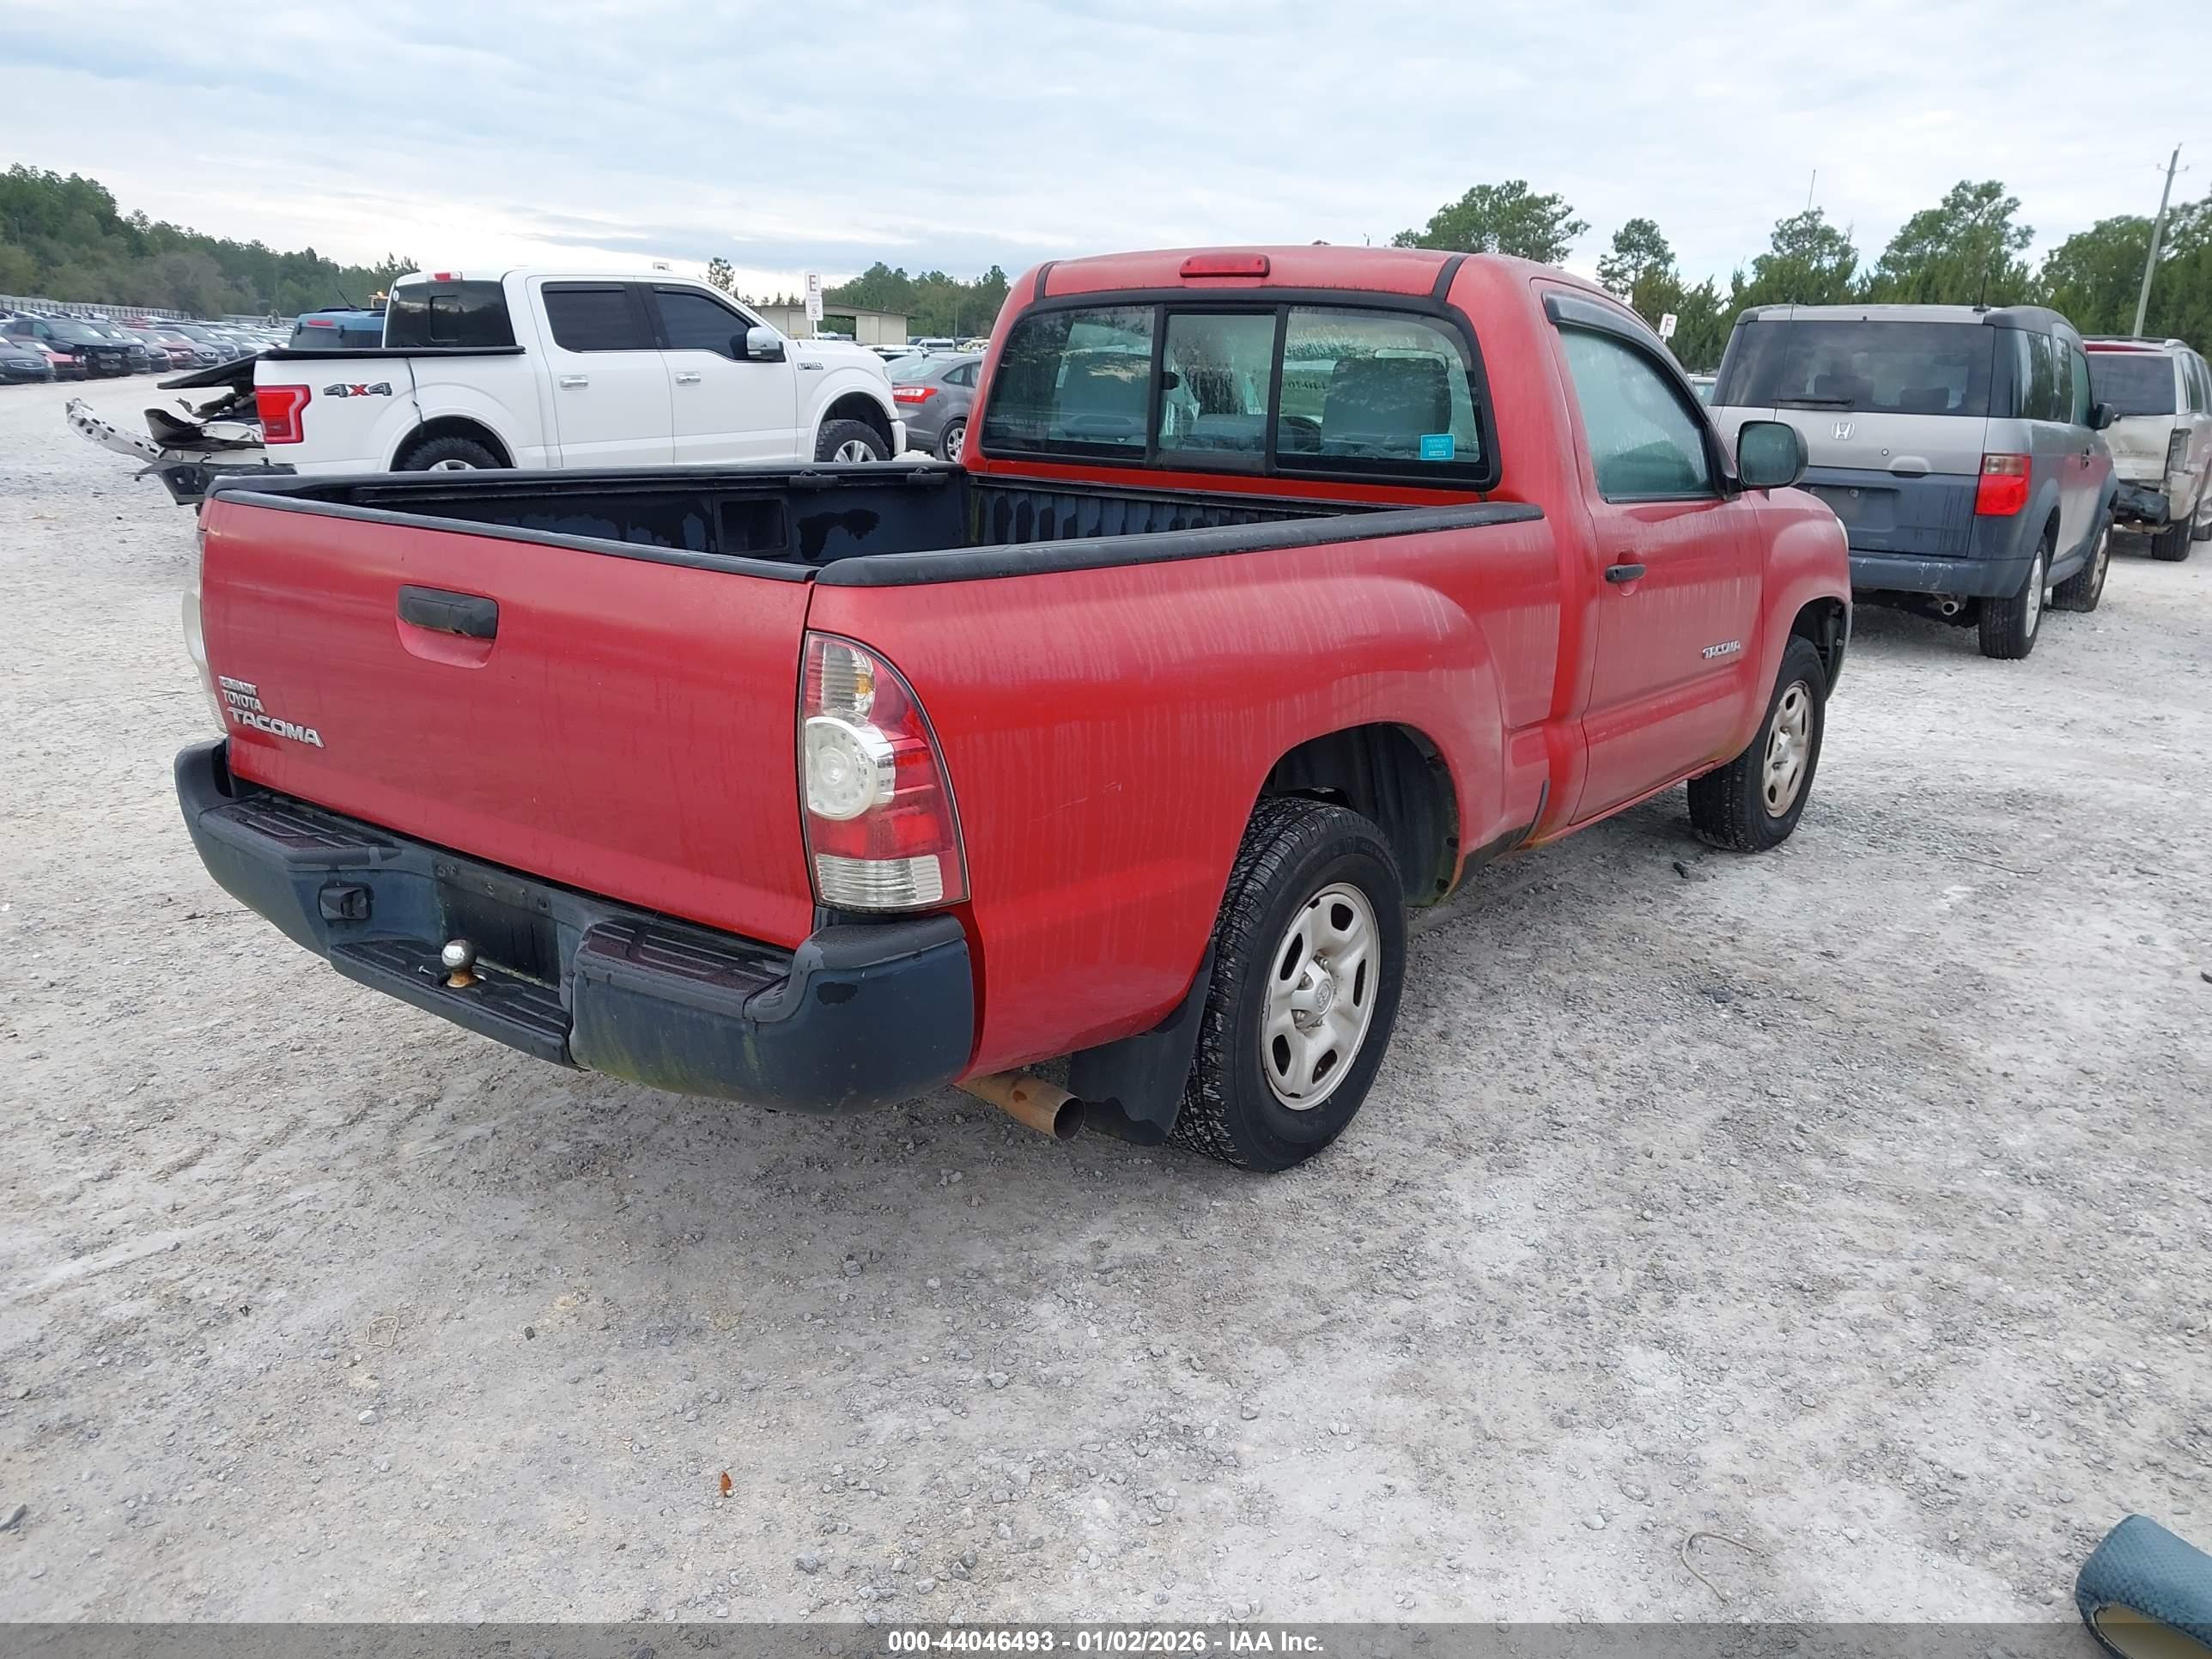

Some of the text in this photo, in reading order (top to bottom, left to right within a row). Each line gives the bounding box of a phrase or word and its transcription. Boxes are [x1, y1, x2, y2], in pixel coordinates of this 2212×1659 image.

[808, 274, 817, 292] E
[1663, 317, 1674, 332] F
[1702, 639, 1741, 659] TACOMA
[222, 689, 265, 713] TOYOTA
[227, 706, 325, 748] TACOMA
